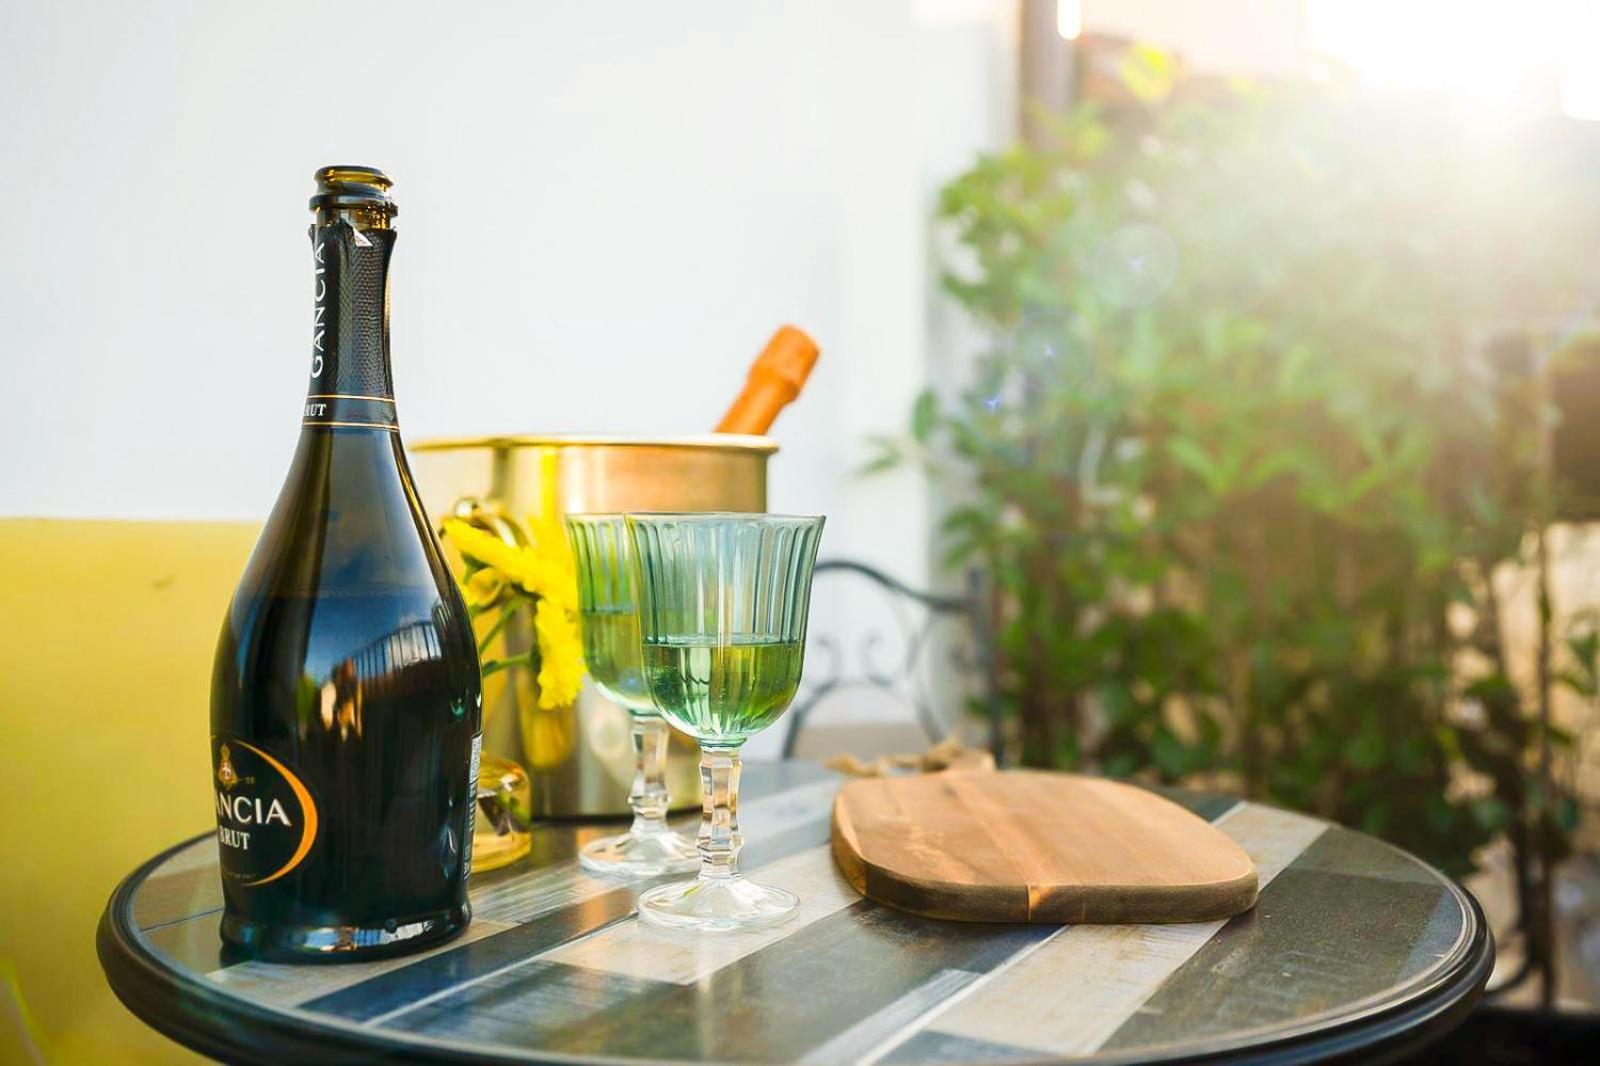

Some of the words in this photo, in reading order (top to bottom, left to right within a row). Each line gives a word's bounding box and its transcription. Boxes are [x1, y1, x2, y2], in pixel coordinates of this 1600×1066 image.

[311, 242, 326, 379] GANCIA
[303, 403, 327, 417] RUT
[216, 791, 292, 827] NCIA
